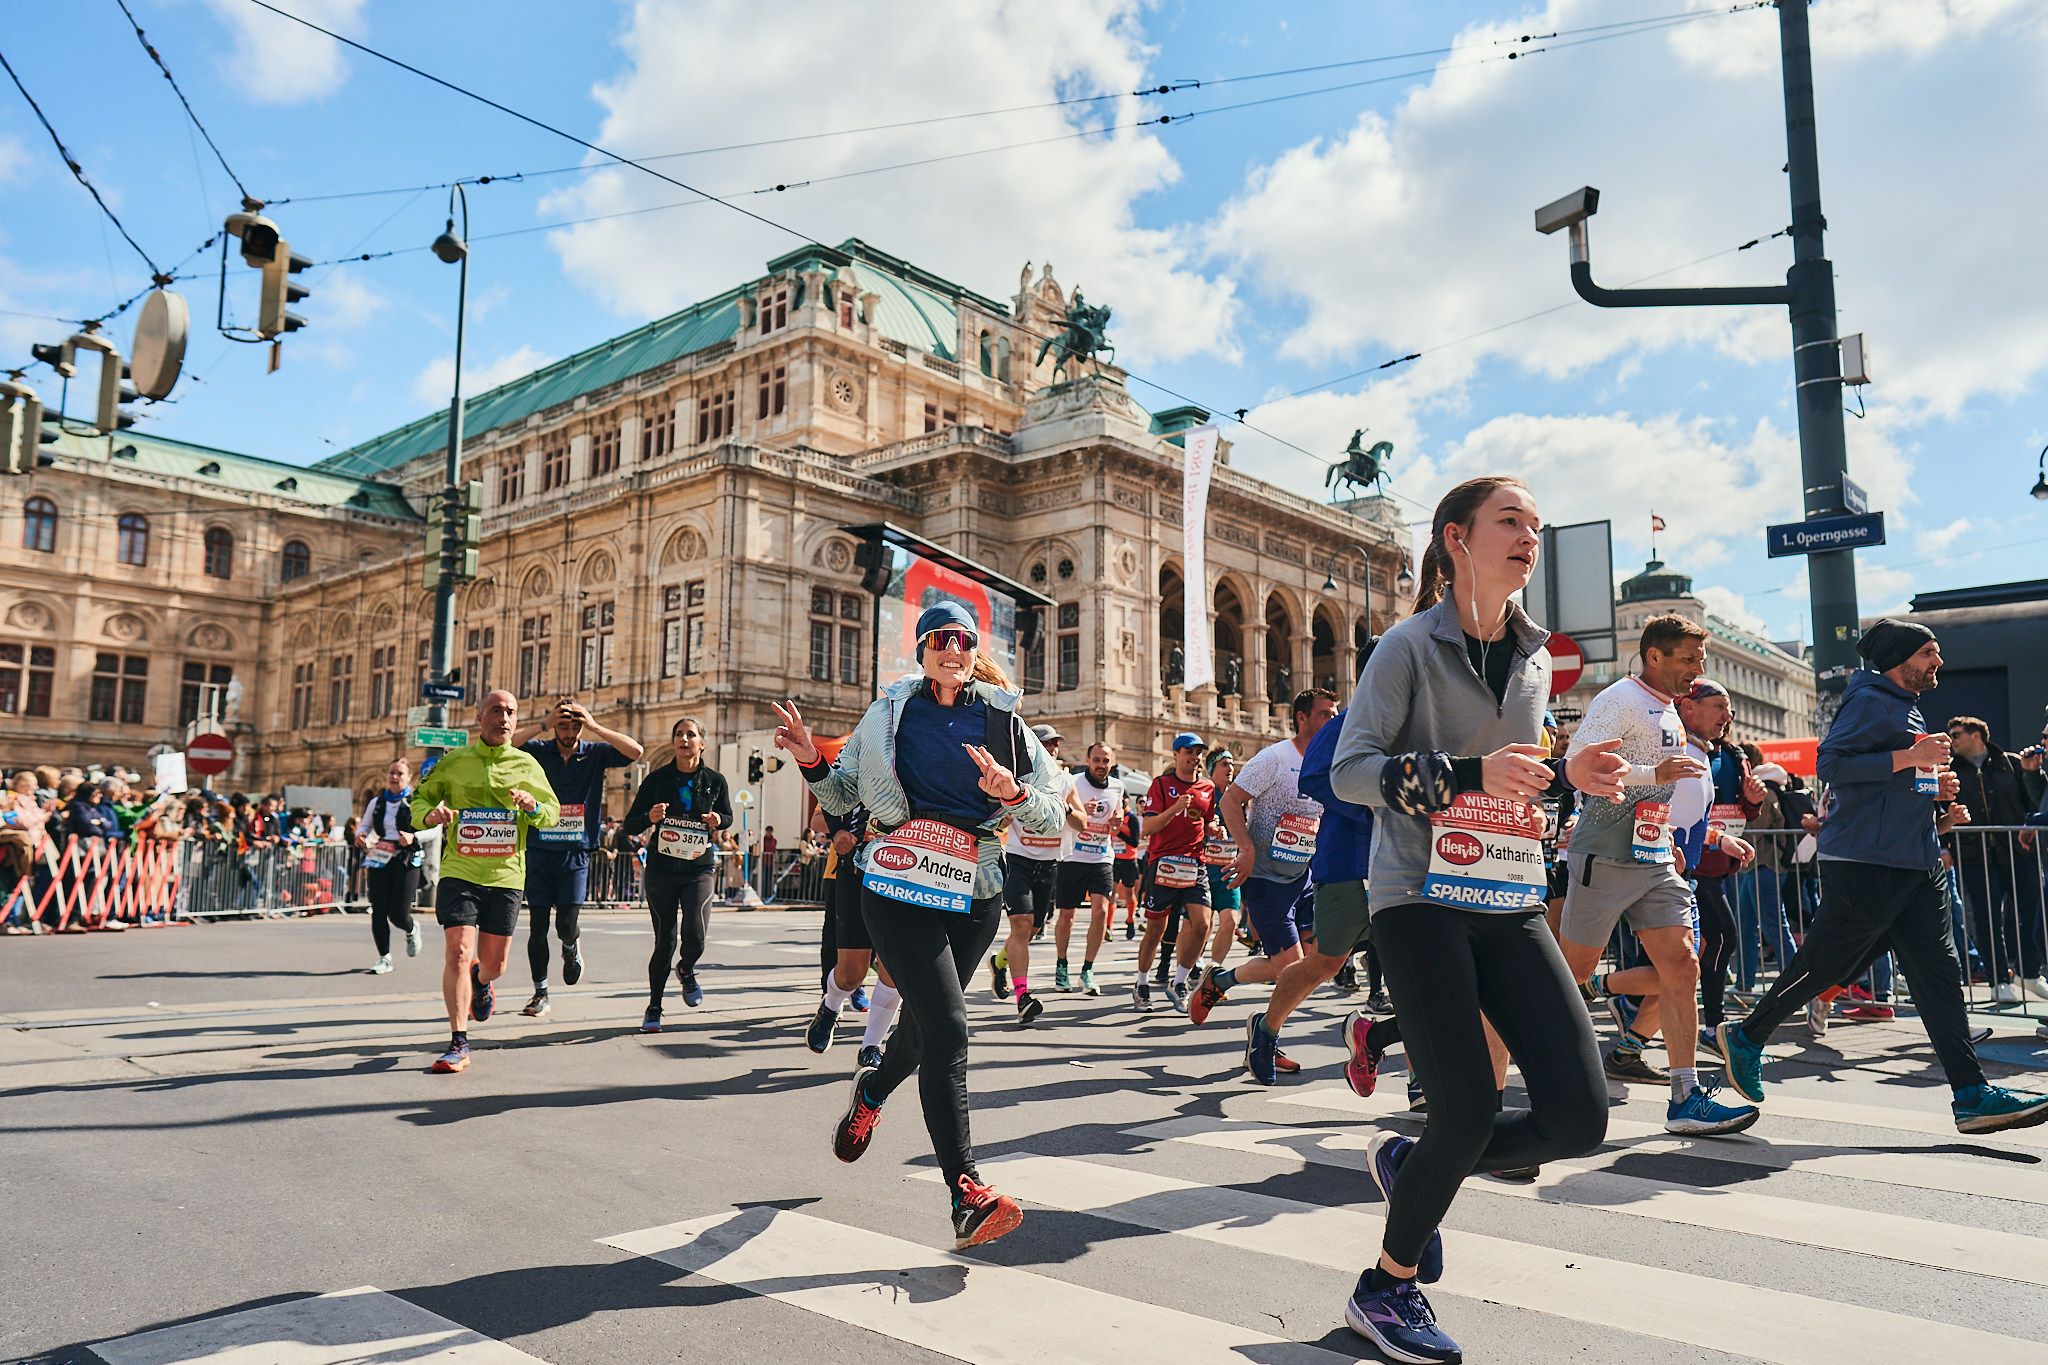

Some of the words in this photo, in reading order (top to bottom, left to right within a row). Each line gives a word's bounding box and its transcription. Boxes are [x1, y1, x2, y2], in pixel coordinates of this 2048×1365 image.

[1796, 526, 1868, 548] Operngasse
[1463, 795, 1513, 812] WIENER
[462, 810, 507, 820] SPARKASSE
[560, 818, 583, 829] Serge
[664, 817, 707, 830] POWERADE
[485, 827, 516, 838] Xavier
[910, 820, 955, 838] WIENER
[682, 833, 705, 846] 387A
[1440, 838, 1481, 859] Hervis
[1486, 843, 1543, 866] Katharina
[878, 849, 914, 867] Hervis
[917, 854, 972, 884] Andrea
[868, 880, 950, 908] SPARKASSE
[1428, 883, 1524, 908] SPARKASSE
